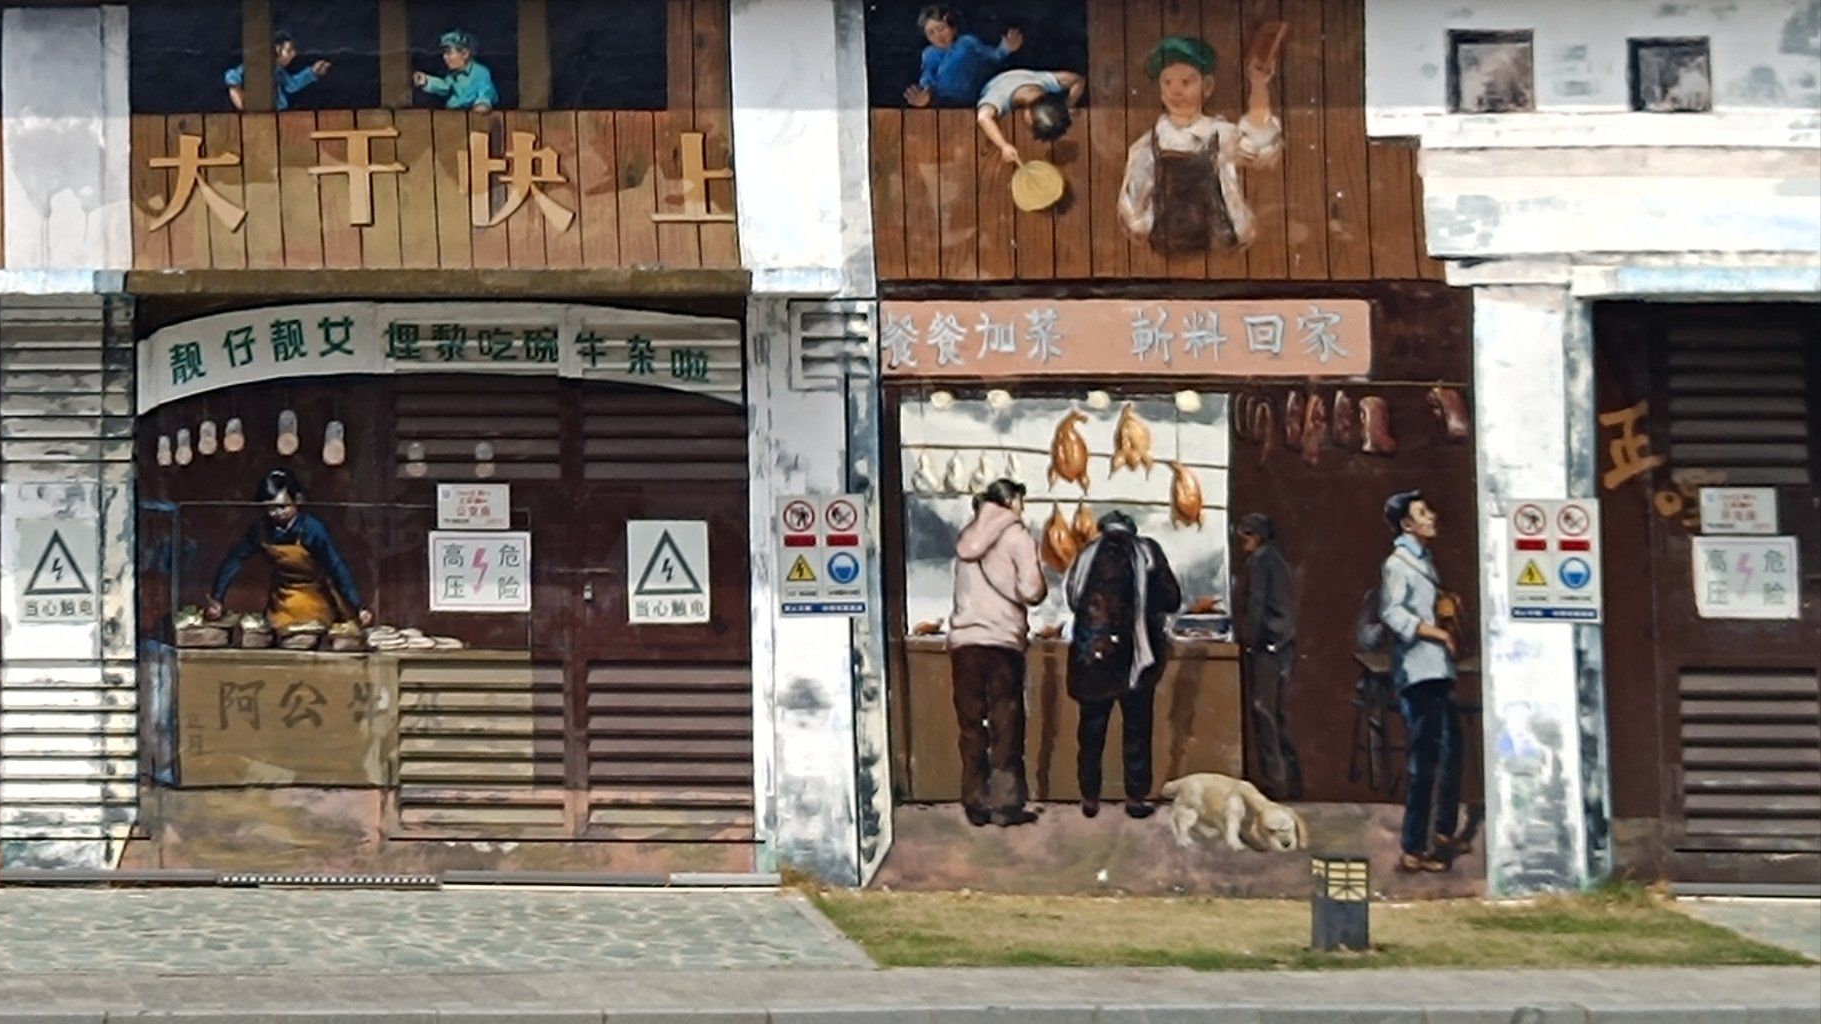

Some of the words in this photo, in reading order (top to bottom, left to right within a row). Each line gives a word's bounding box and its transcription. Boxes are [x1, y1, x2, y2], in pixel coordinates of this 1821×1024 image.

[148, 126, 734, 232] 大干快上
[880, 308, 1063, 368] 餐餐加菜
